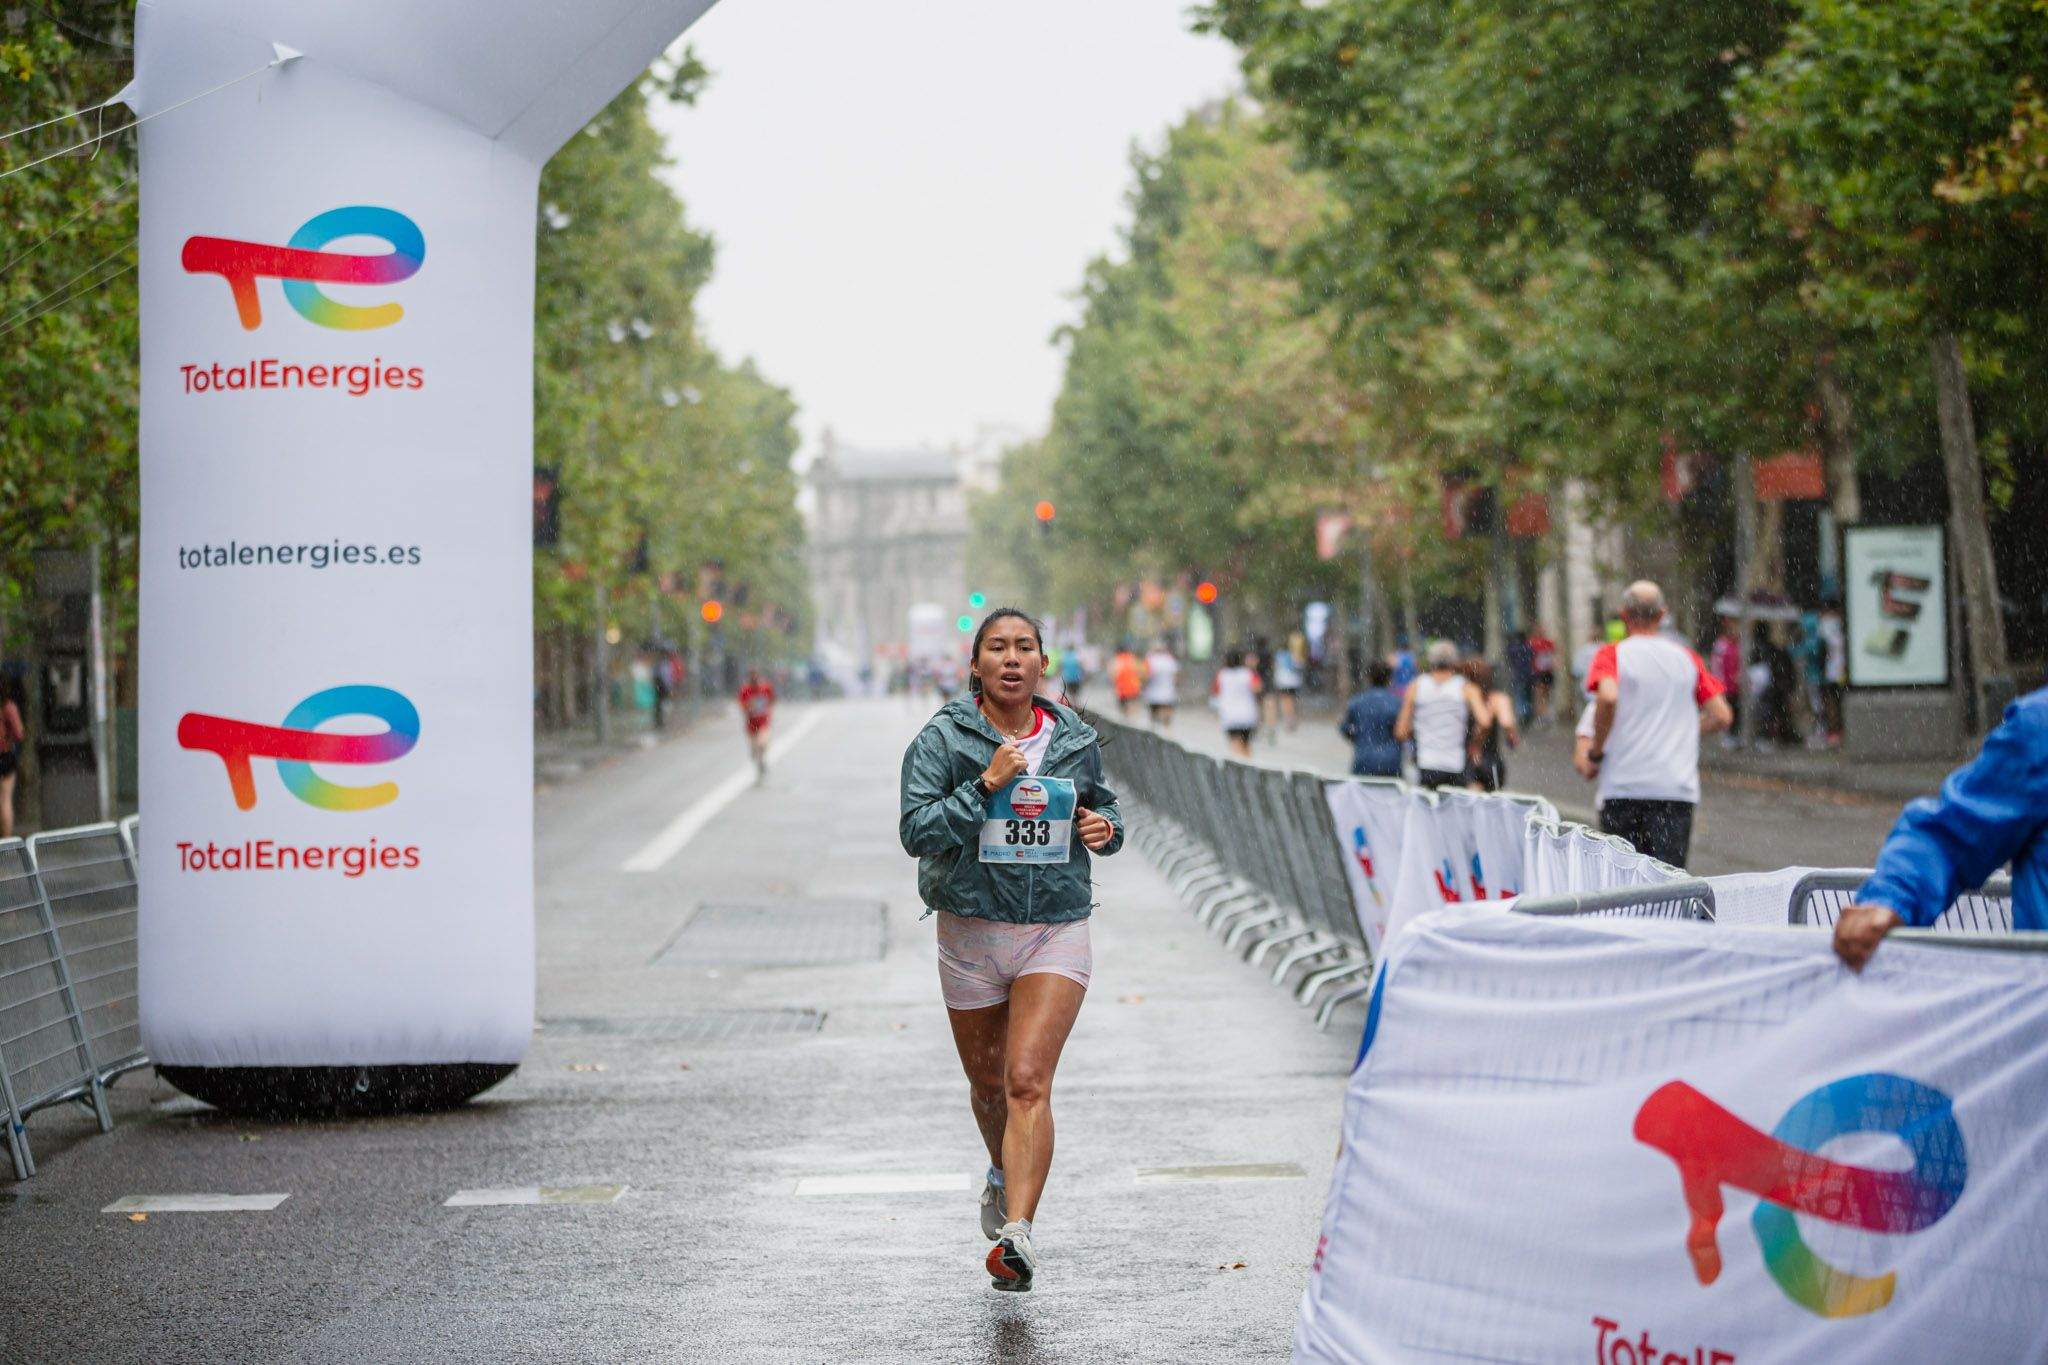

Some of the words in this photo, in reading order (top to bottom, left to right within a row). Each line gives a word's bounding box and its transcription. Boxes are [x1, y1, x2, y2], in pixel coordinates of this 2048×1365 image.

[180, 357, 424, 396] TotalEnergies
[178, 539, 422, 569] totalenergies.es
[1005, 819, 1051, 845] 333
[177, 837, 421, 877] TotalEnergies
